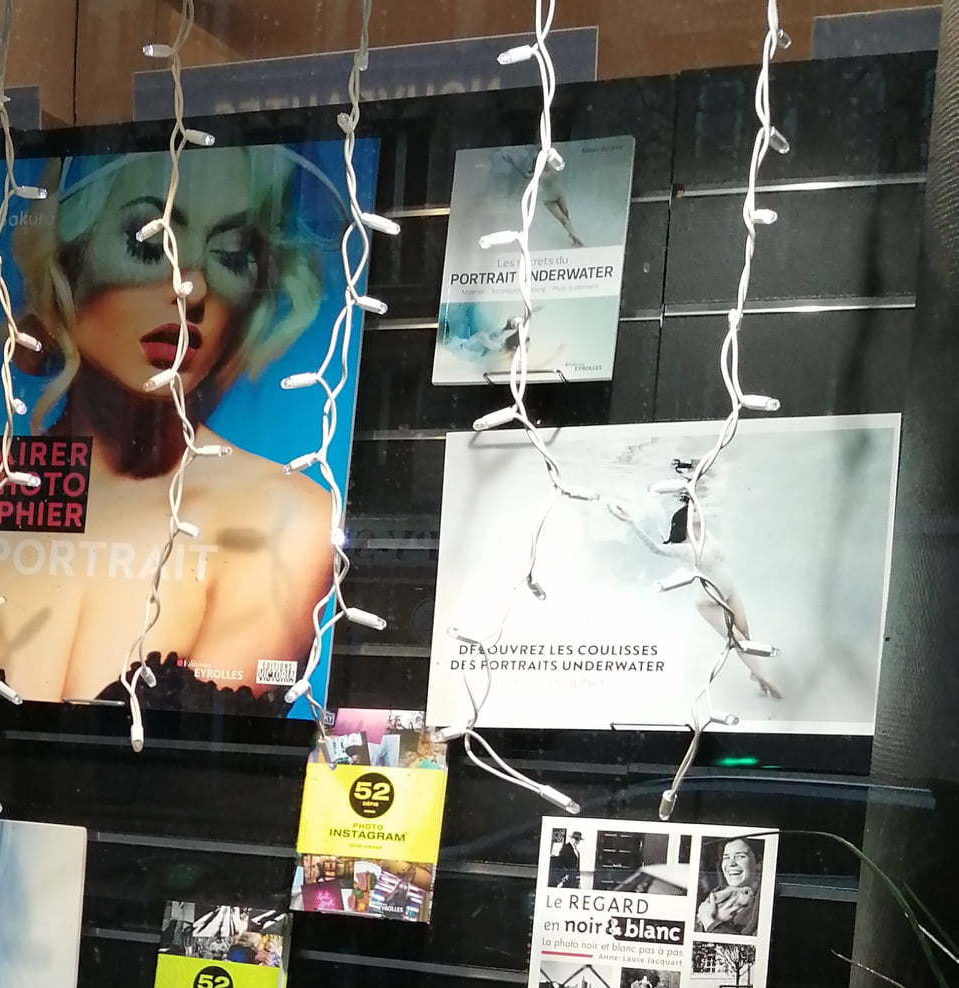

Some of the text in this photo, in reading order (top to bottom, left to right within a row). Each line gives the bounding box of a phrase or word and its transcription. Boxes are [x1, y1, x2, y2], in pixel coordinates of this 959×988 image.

[498, 256, 568, 268] Les du
[450, 266, 614, 284] PORTRAIT NDERWATER
[550, 644, 658, 656] LES COULISSES
[450, 660, 665, 672] DES PORTRAITS UNDERWATER
[194, 668, 243, 681] EYROLLES
[353, 781, 391, 802] 52
[353, 822, 384, 831] PHOTO
[329, 828, 406, 842] INSTAGRAM
[546, 894, 648, 914] Le REGARD
[544, 917, 682, 940] en noir & blanc
[542, 938, 684, 958] La photo noir et blanc pas pas
[598, 954, 683, 967] Anne-Laure Jacquart
